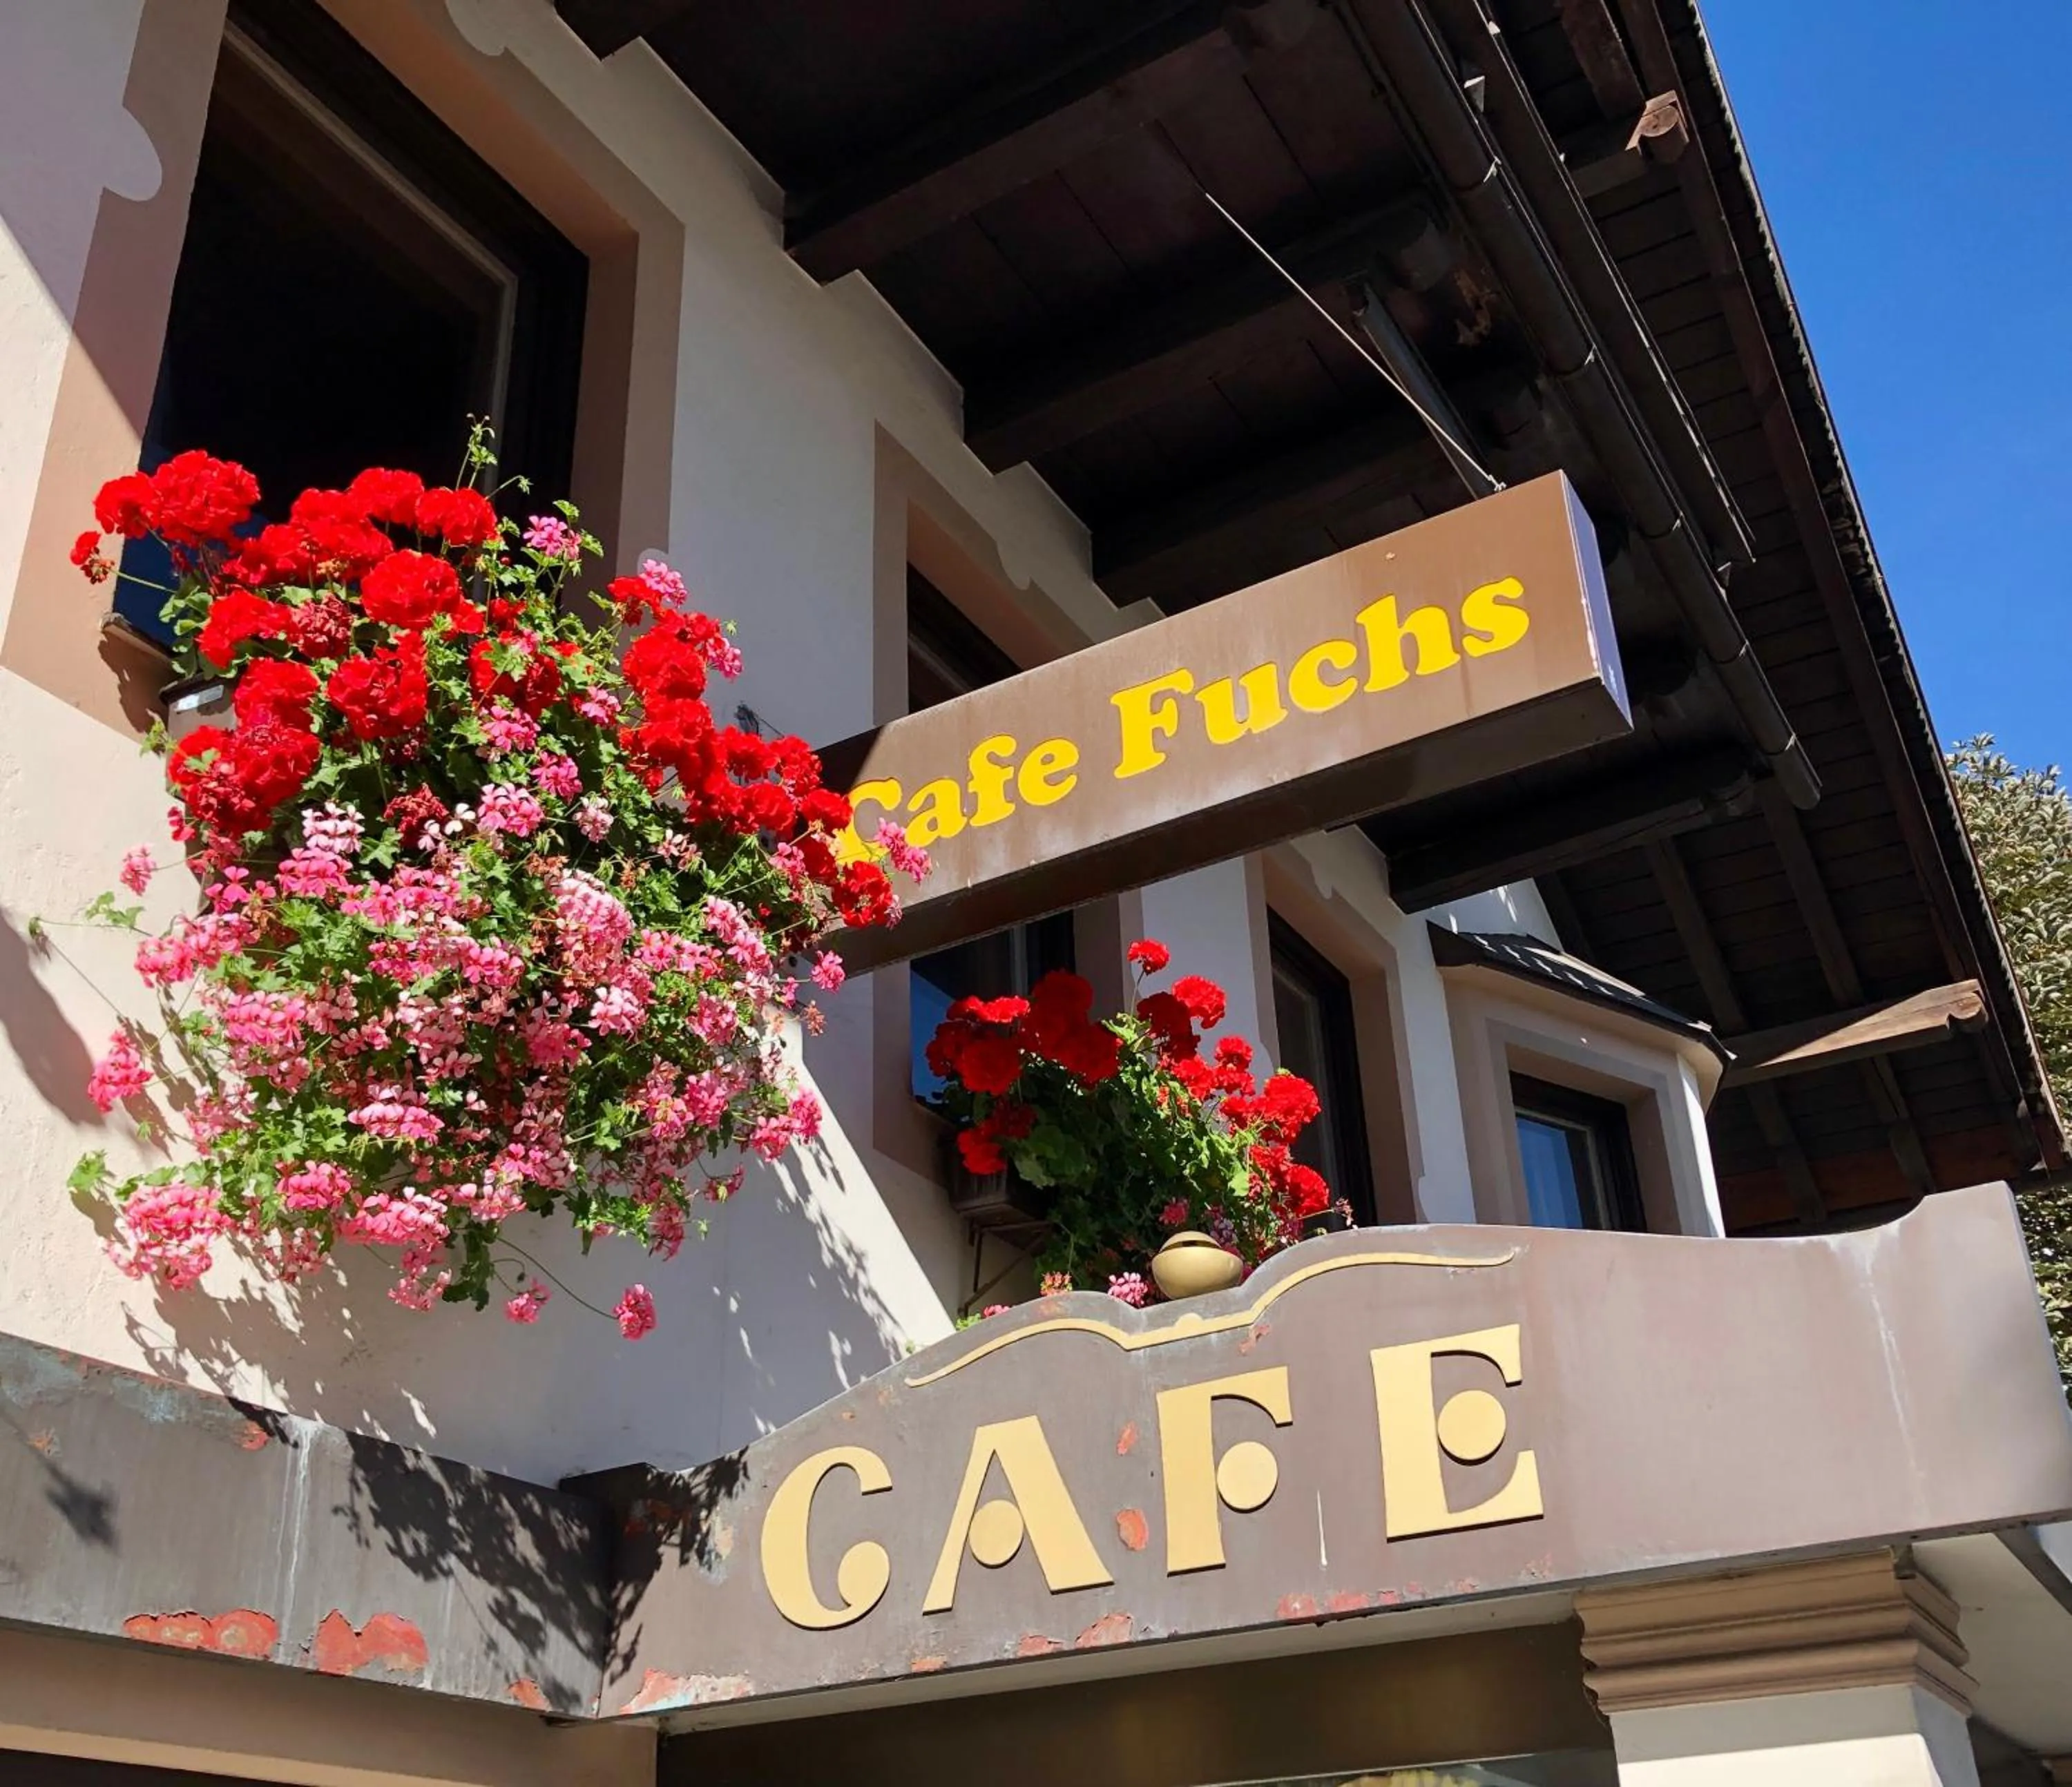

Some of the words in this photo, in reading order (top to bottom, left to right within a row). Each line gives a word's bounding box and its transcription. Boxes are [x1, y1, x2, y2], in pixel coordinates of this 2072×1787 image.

[835, 734, 1080, 864] Cafe
[1111, 577, 1529, 778] Fuchs
[760, 1324, 1544, 1629] CAFE
